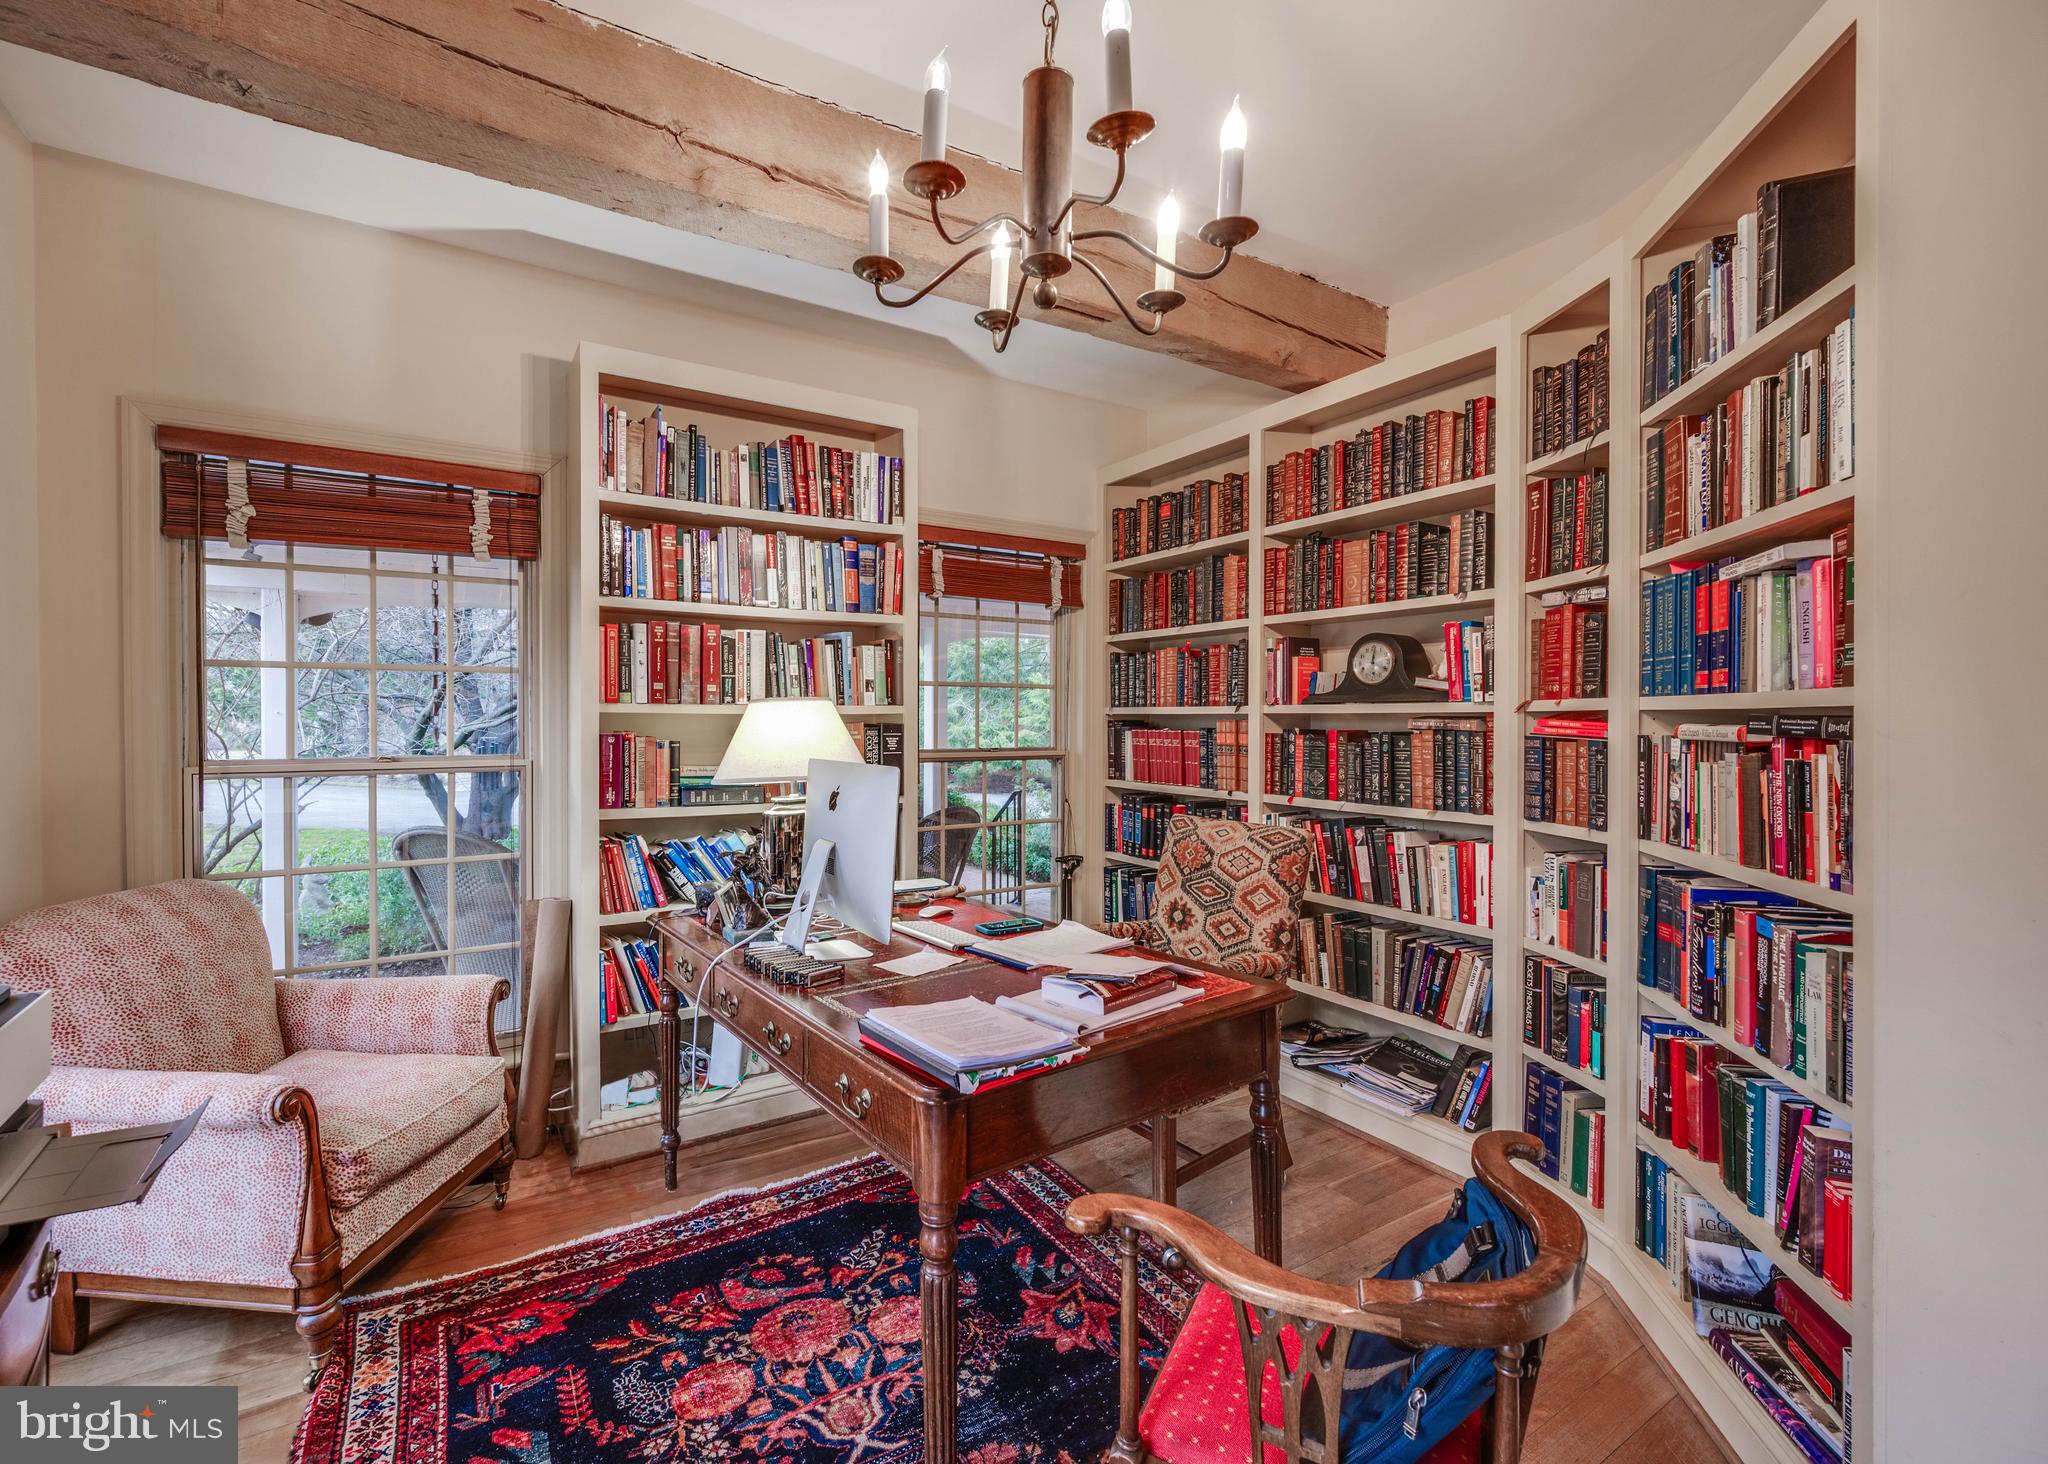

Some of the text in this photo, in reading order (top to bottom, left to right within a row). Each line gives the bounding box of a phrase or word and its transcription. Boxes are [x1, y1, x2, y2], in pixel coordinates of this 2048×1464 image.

[1802, 600, 1810, 644] ENGLISH
[1692, 923, 1704, 991] Fowler's
[1525, 990, 1533, 1024] THESAURUS
[1807, 988, 1822, 1001] LAW
[1391, 1039, 1406, 1048] SKY
[1412, 1049, 1452, 1067] TELESCOP
